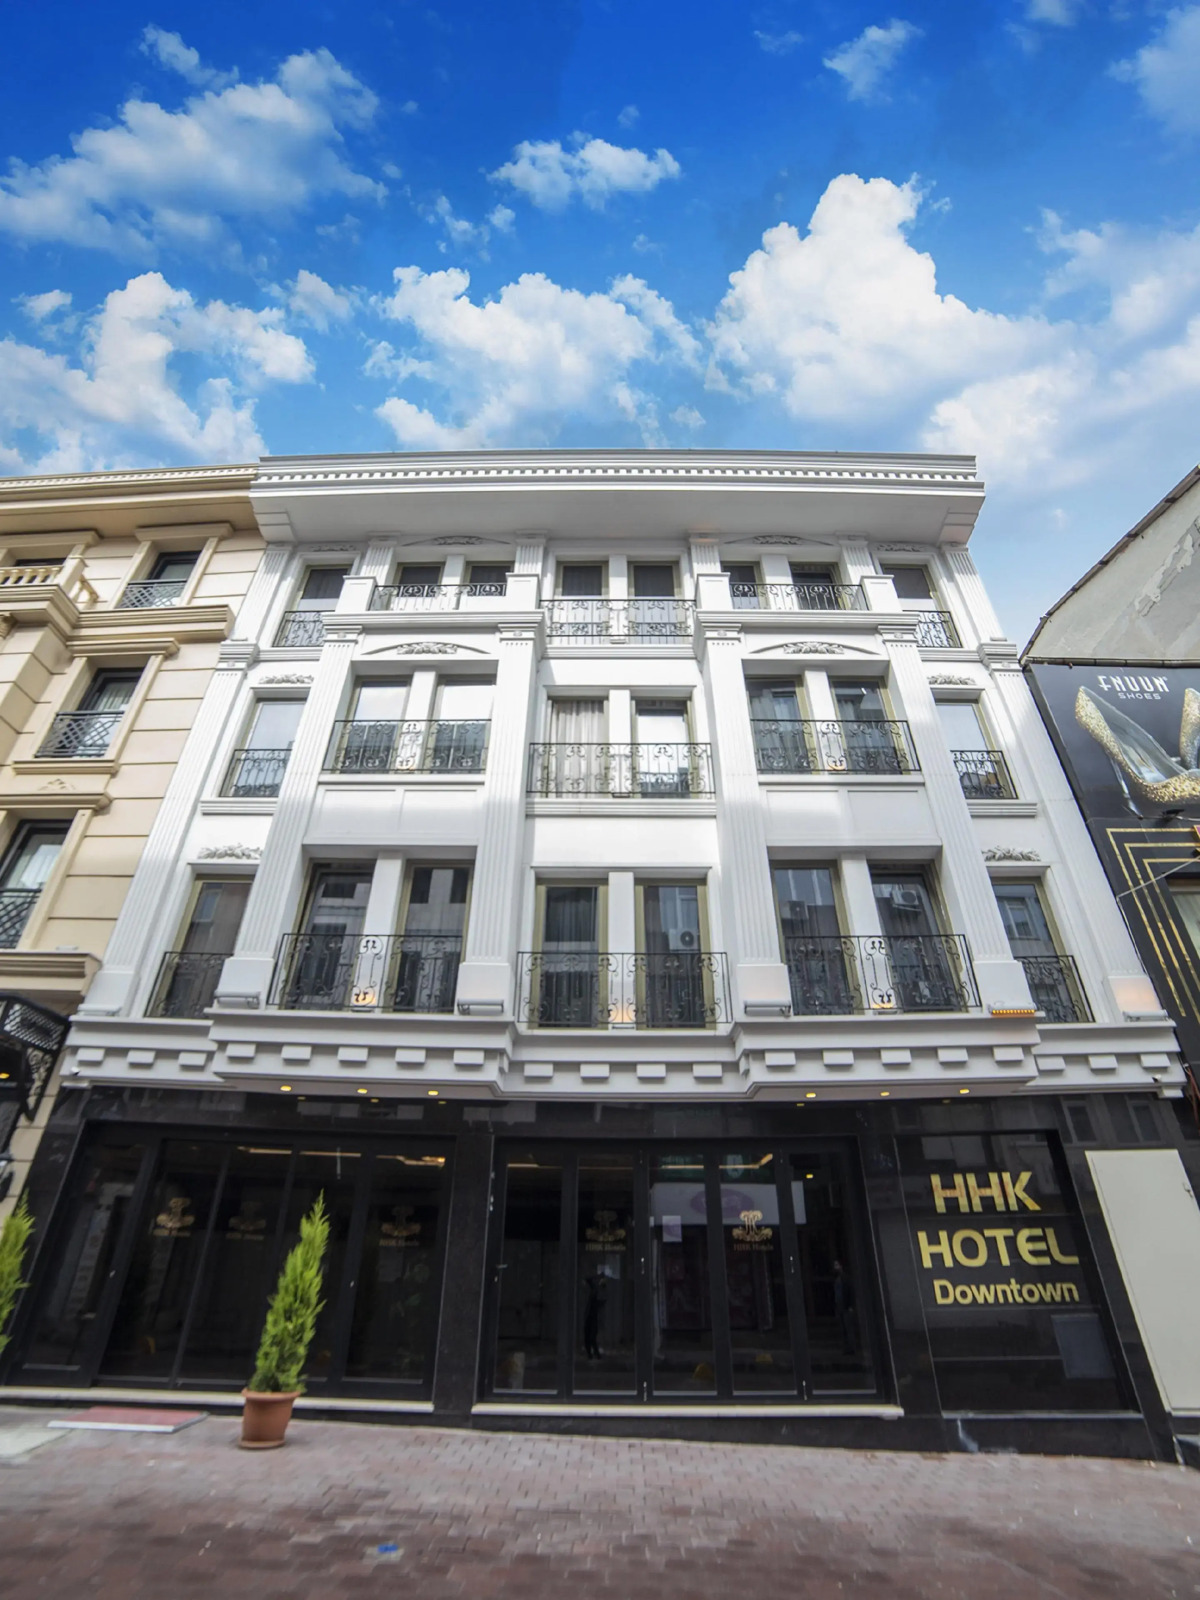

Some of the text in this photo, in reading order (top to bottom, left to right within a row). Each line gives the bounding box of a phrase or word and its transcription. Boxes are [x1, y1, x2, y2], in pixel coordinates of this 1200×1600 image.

[1118, 692, 1161, 700] SHOES
[930, 1171, 1042, 1213] HHK
[917, 1227, 1080, 1269] HOTEL
[933, 1278, 1080, 1305] Downtown
